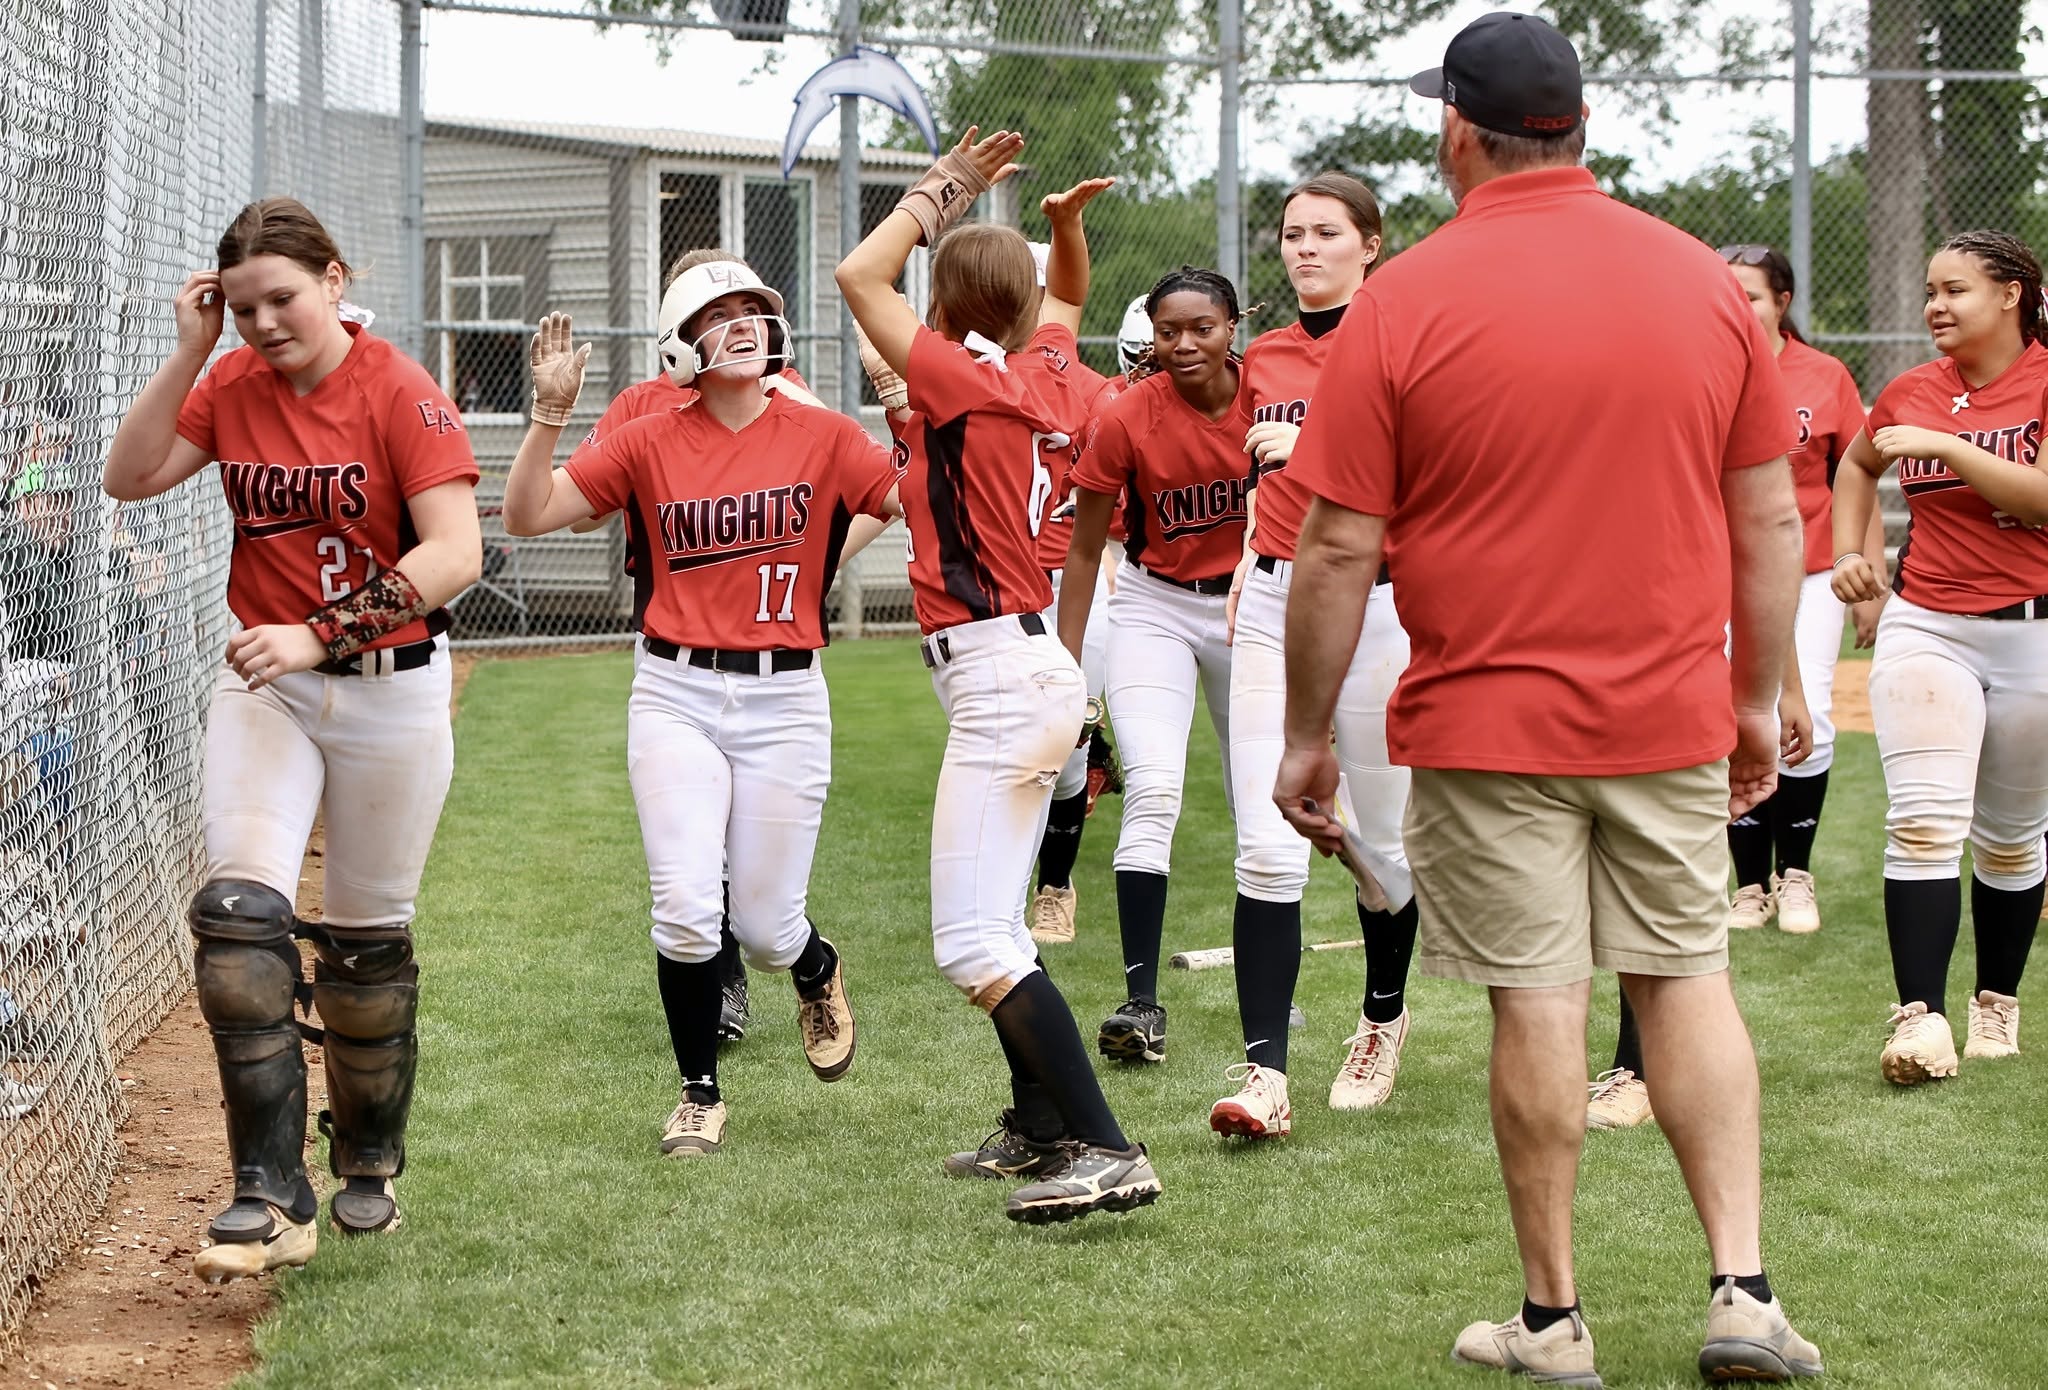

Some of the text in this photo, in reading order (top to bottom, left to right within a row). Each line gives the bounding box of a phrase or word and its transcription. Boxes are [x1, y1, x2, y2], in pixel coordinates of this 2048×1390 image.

[416, 400, 462, 435] EA
[1028, 431, 1071, 537] 6
[1152, 478, 1248, 530] KNIGH
[656, 482, 814, 554] KNIGHTS
[754, 563, 801, 623] 17
